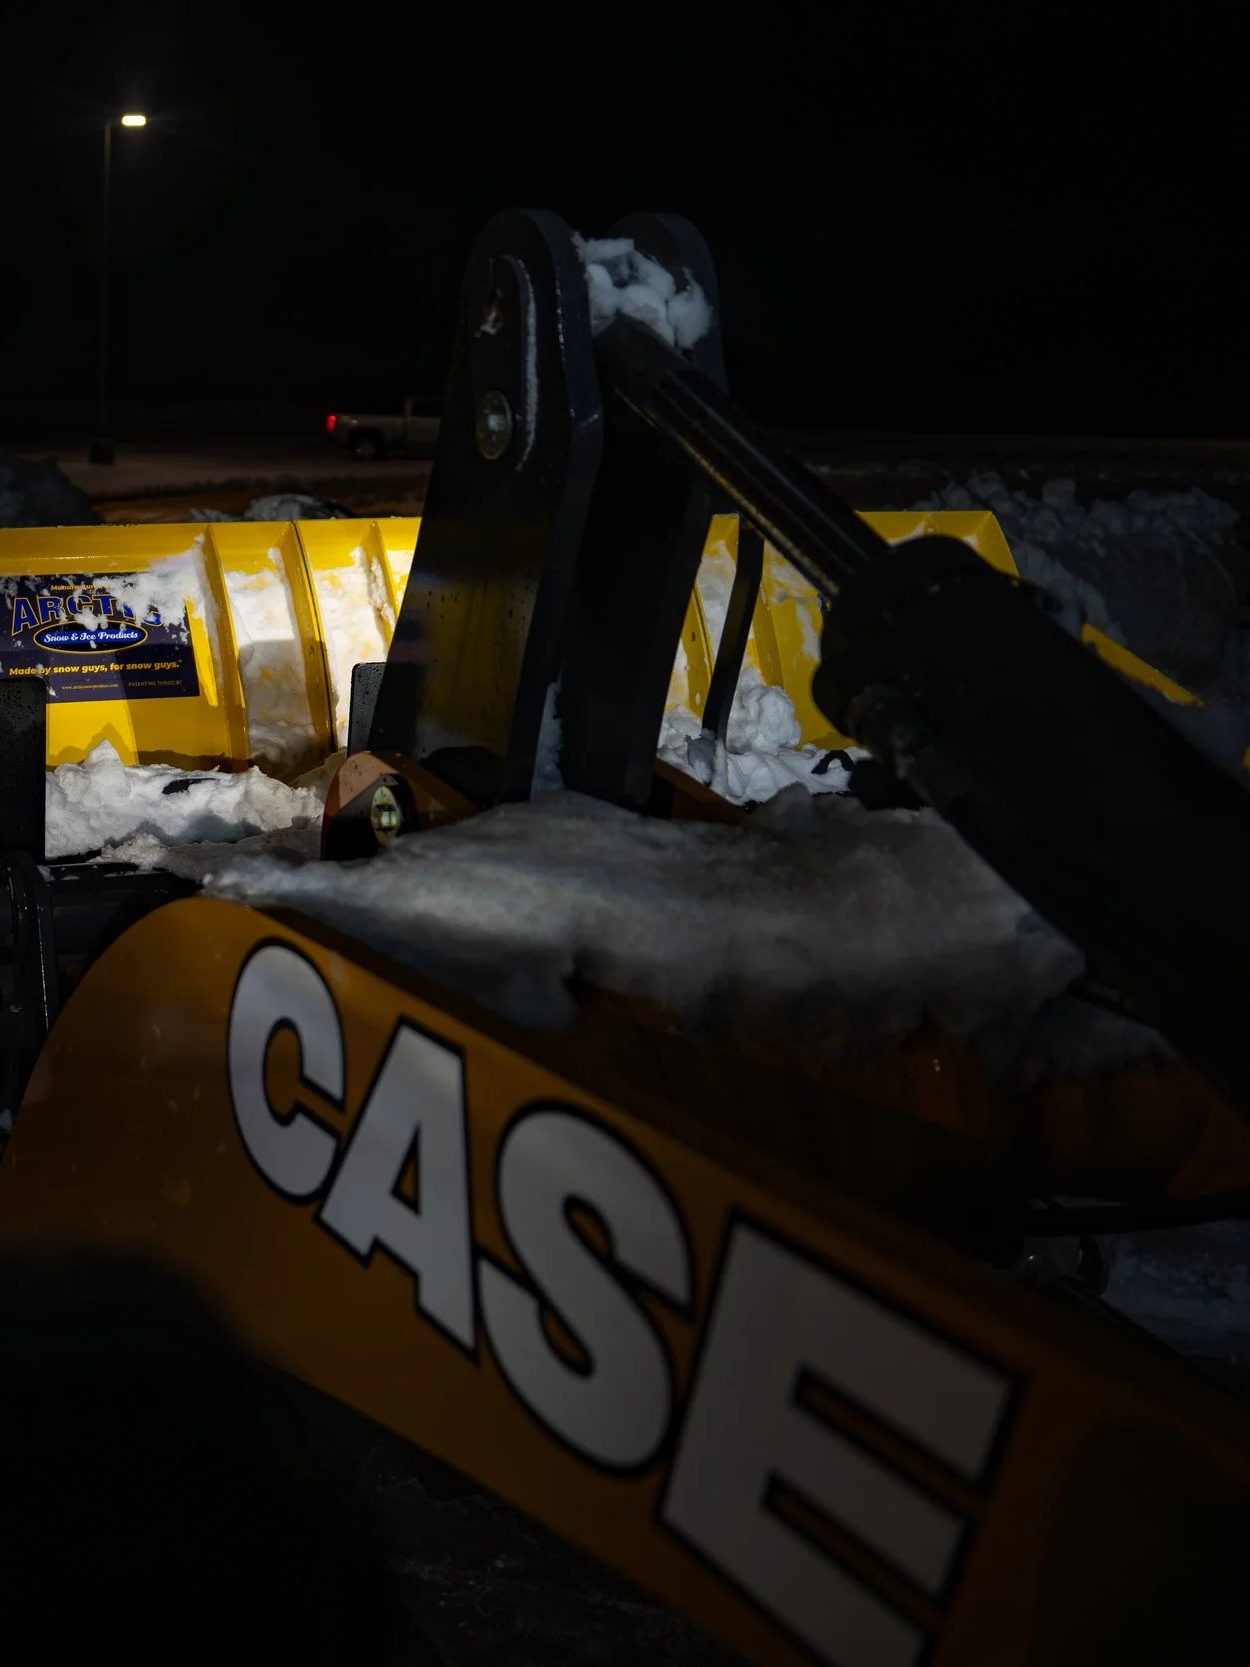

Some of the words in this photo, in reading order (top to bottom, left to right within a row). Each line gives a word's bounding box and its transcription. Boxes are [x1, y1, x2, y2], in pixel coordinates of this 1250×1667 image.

[44, 634, 69, 643] Snow
[79, 632, 96, 640] Ice
[97, 631, 138, 640] Products
[9, 667, 36, 675] Made
[53, 665, 79, 673] snow
[81, 664, 108, 673] guys,
[110, 662, 124, 670] for
[126, 662, 152, 670] snow
[154, 661, 179, 670] guys.
[226, 937, 1025, 1667] CASE
